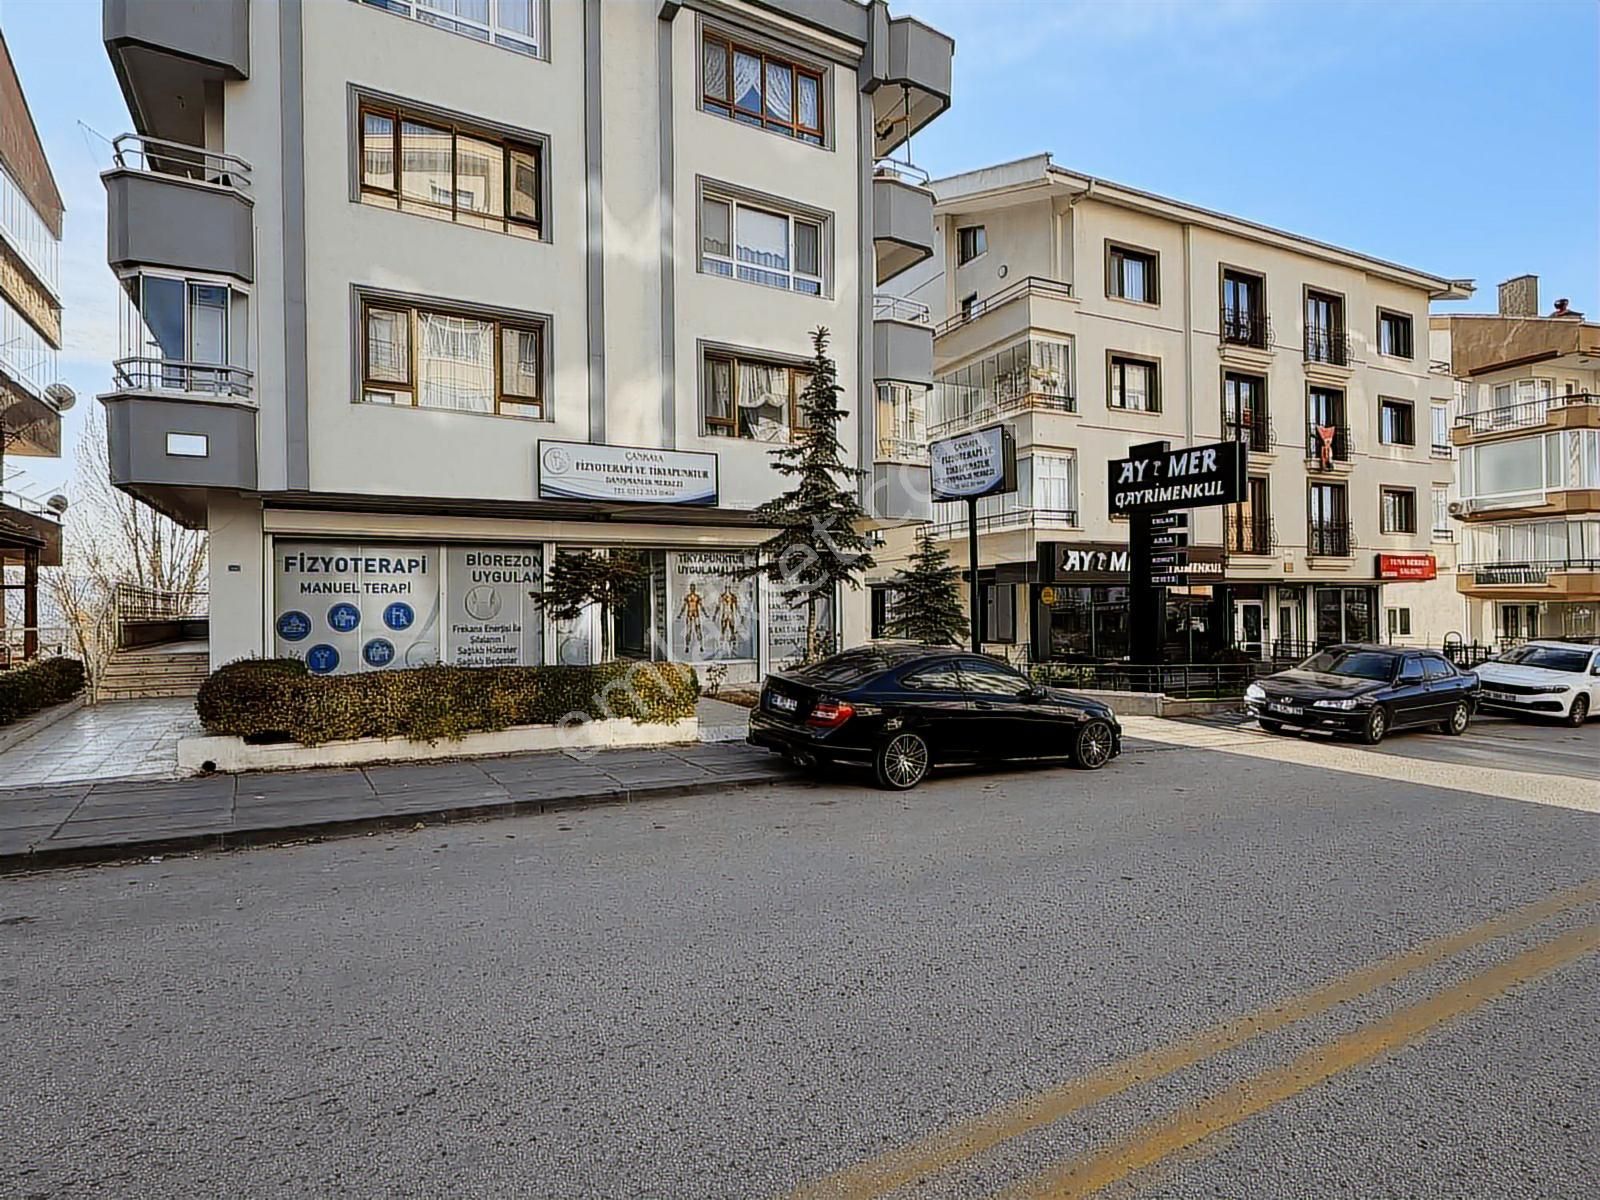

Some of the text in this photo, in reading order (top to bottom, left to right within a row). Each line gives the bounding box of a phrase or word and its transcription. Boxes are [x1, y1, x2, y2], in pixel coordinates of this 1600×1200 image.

[284, 552, 427, 574] FİZYOTERAPİ
[300, 581, 411, 594] MANUEL TERAPİ
